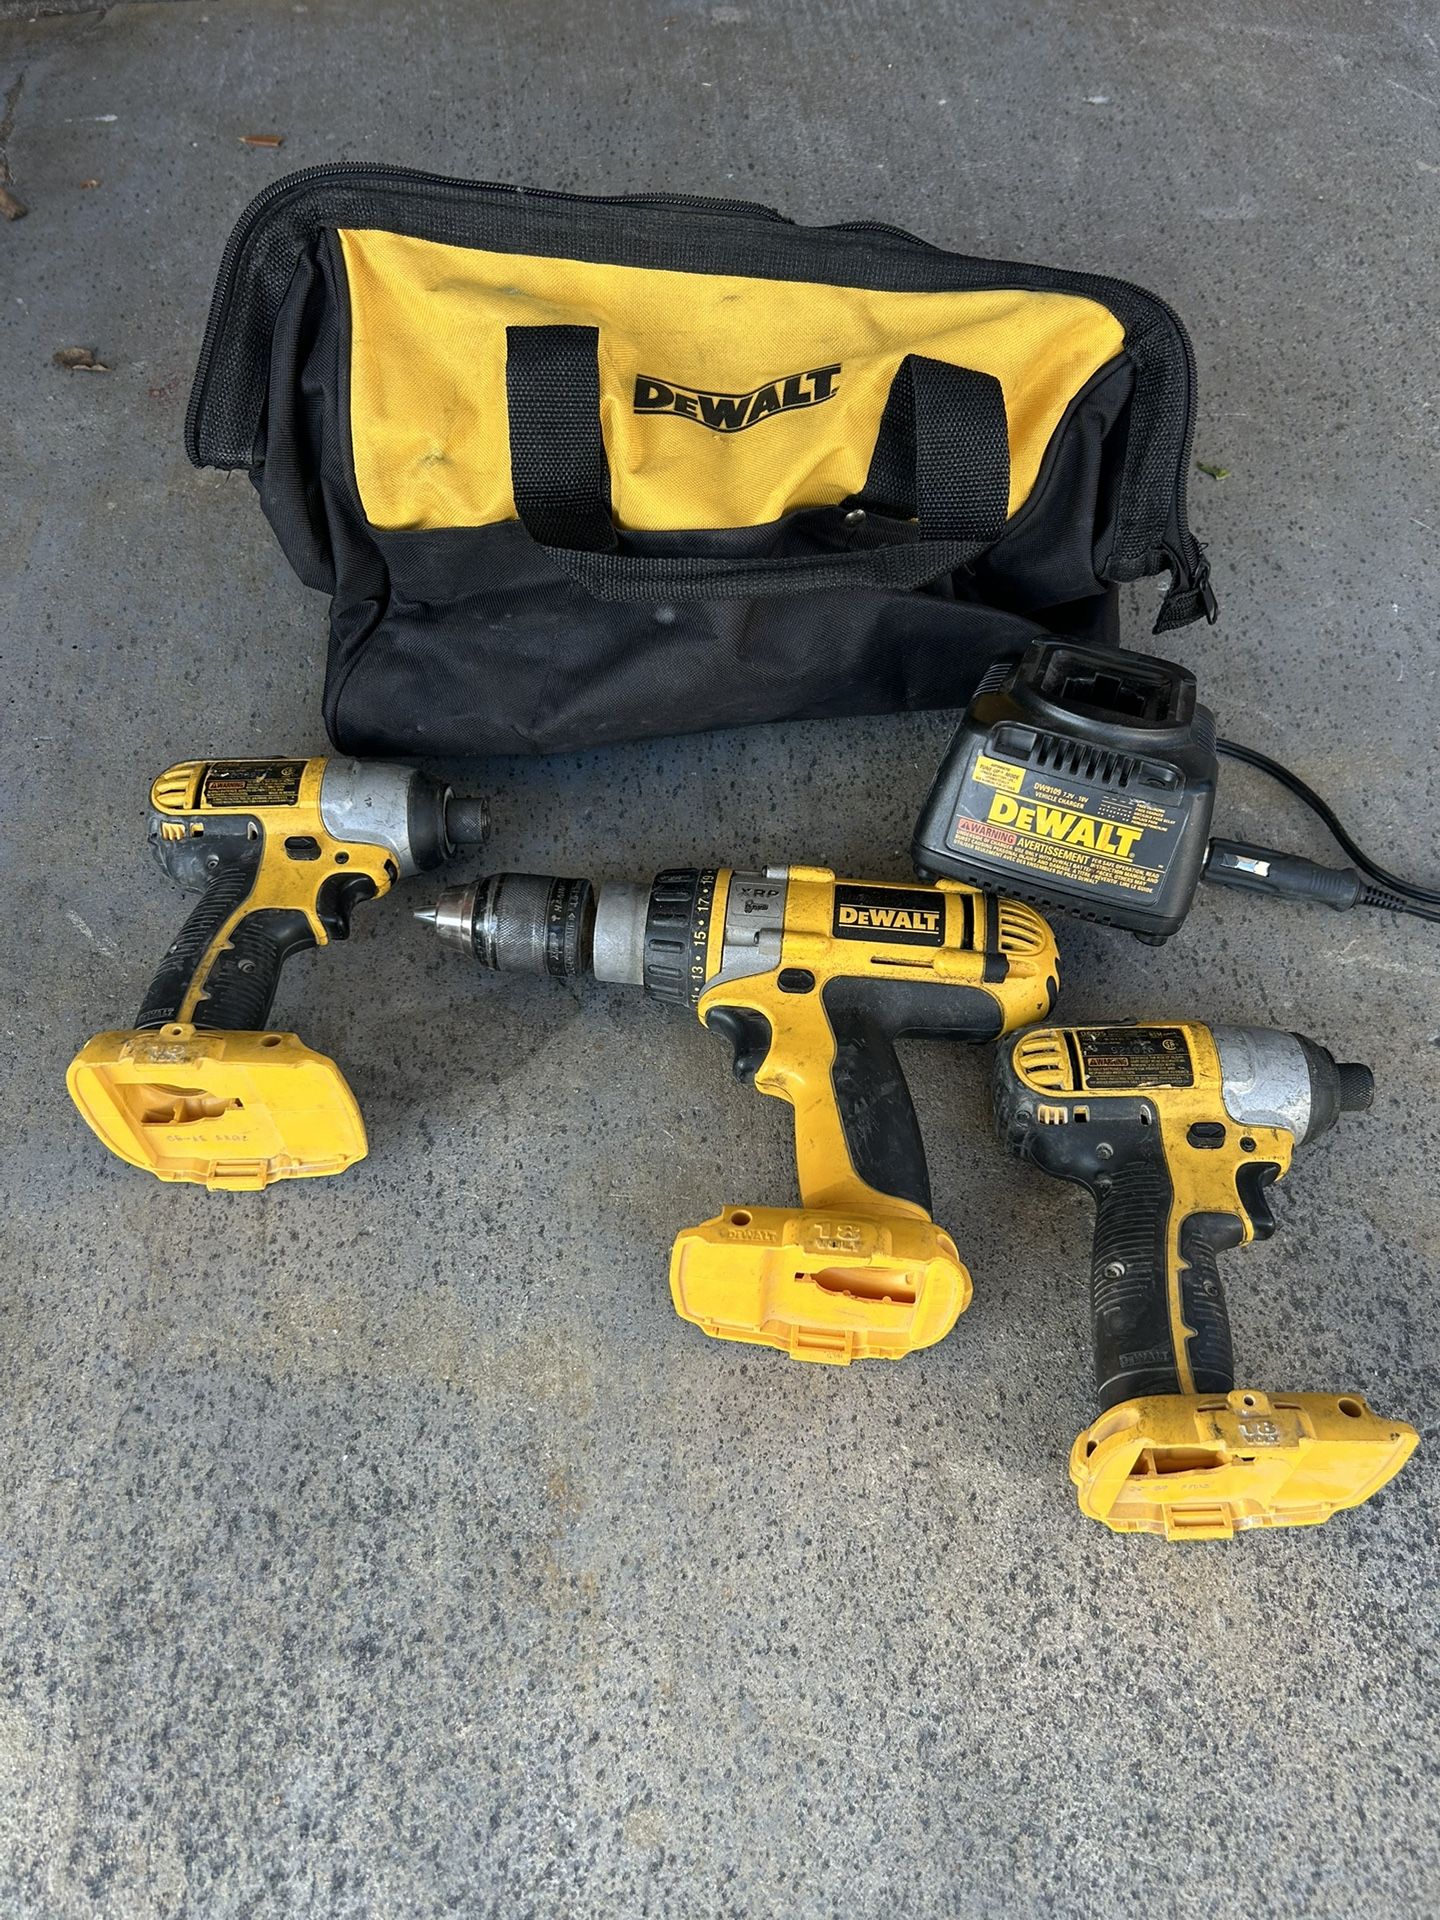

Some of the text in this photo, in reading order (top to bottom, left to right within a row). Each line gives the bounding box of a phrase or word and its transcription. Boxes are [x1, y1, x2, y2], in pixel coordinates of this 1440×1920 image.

[634, 365, 842, 431] DEWALT
[1034, 782, 1063, 796] DW9109
[1035, 792, 1085, 809] VEHICLE CHARGER
[971, 823, 1015, 844] WARNING
[988, 792, 1143, 858] DEWALT
[971, 839, 994, 849] CAUSING
[993, 846, 1019, 857] PERSONAL
[1019, 854, 1037, 862] INJURY
[975, 845, 1004, 858] SEULEMENT
[1003, 854, 1017, 862] AVEC
[1027, 861, 1056, 873] ENSEMBLES
[1018, 838, 1091, 865] AVERTISSEMENT
[1025, 850, 1039, 858] ONLY
[1091, 863, 1124, 875] INSTRUCTION
[1124, 871, 1147, 881] MANUAL
[1146, 871, 1161, 879] READ
[737, 887, 780, 899] XRP
[696, 897, 711, 912] 17
[838, 906, 940, 931] DEWALT
[693, 931, 707, 947] 15
[691, 965, 704, 980] 13
[813, 1223, 860, 1241] 18
